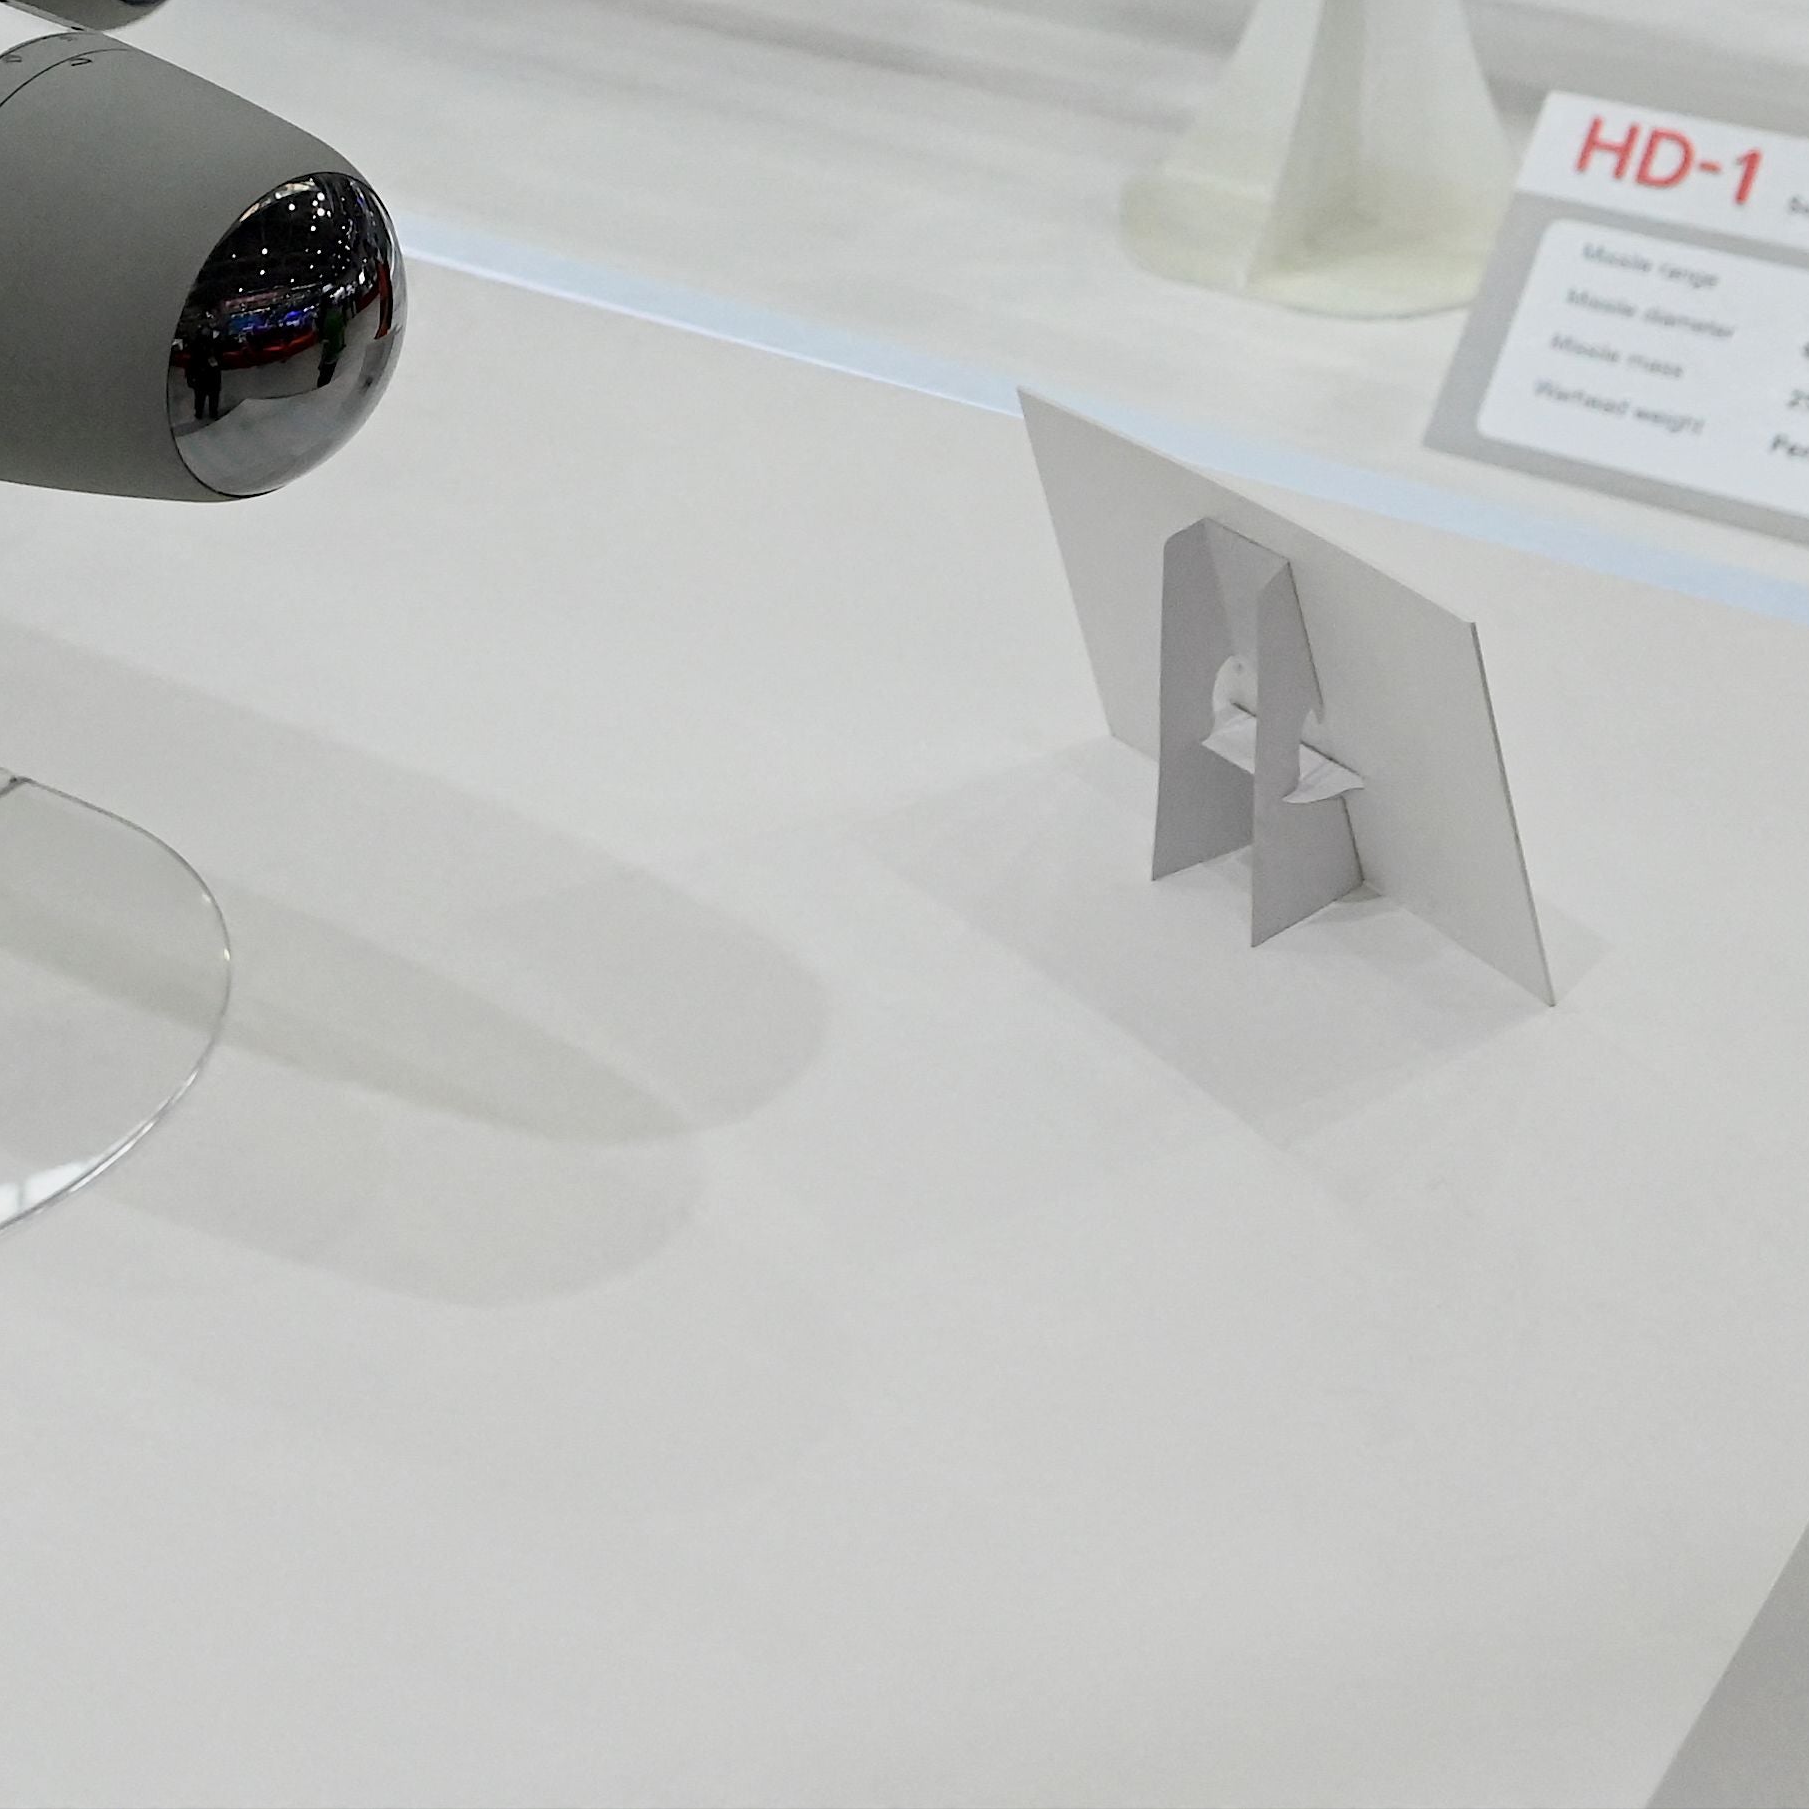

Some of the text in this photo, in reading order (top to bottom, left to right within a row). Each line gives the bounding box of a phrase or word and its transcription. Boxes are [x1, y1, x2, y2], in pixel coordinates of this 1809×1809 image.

[1576, 114, 1764, 206] HD-1
[1582, 243, 1652, 274] Missile
[1658, 262, 1719, 290] range
[1566, 289, 1635, 318] Missile
[1643, 307, 1736, 339] diameter
[1549, 333, 1620, 363] Missile
[1627, 354, 1684, 379] mass
[1534, 379, 1630, 415] Warhead
[1634, 406, 1706, 436] weight
